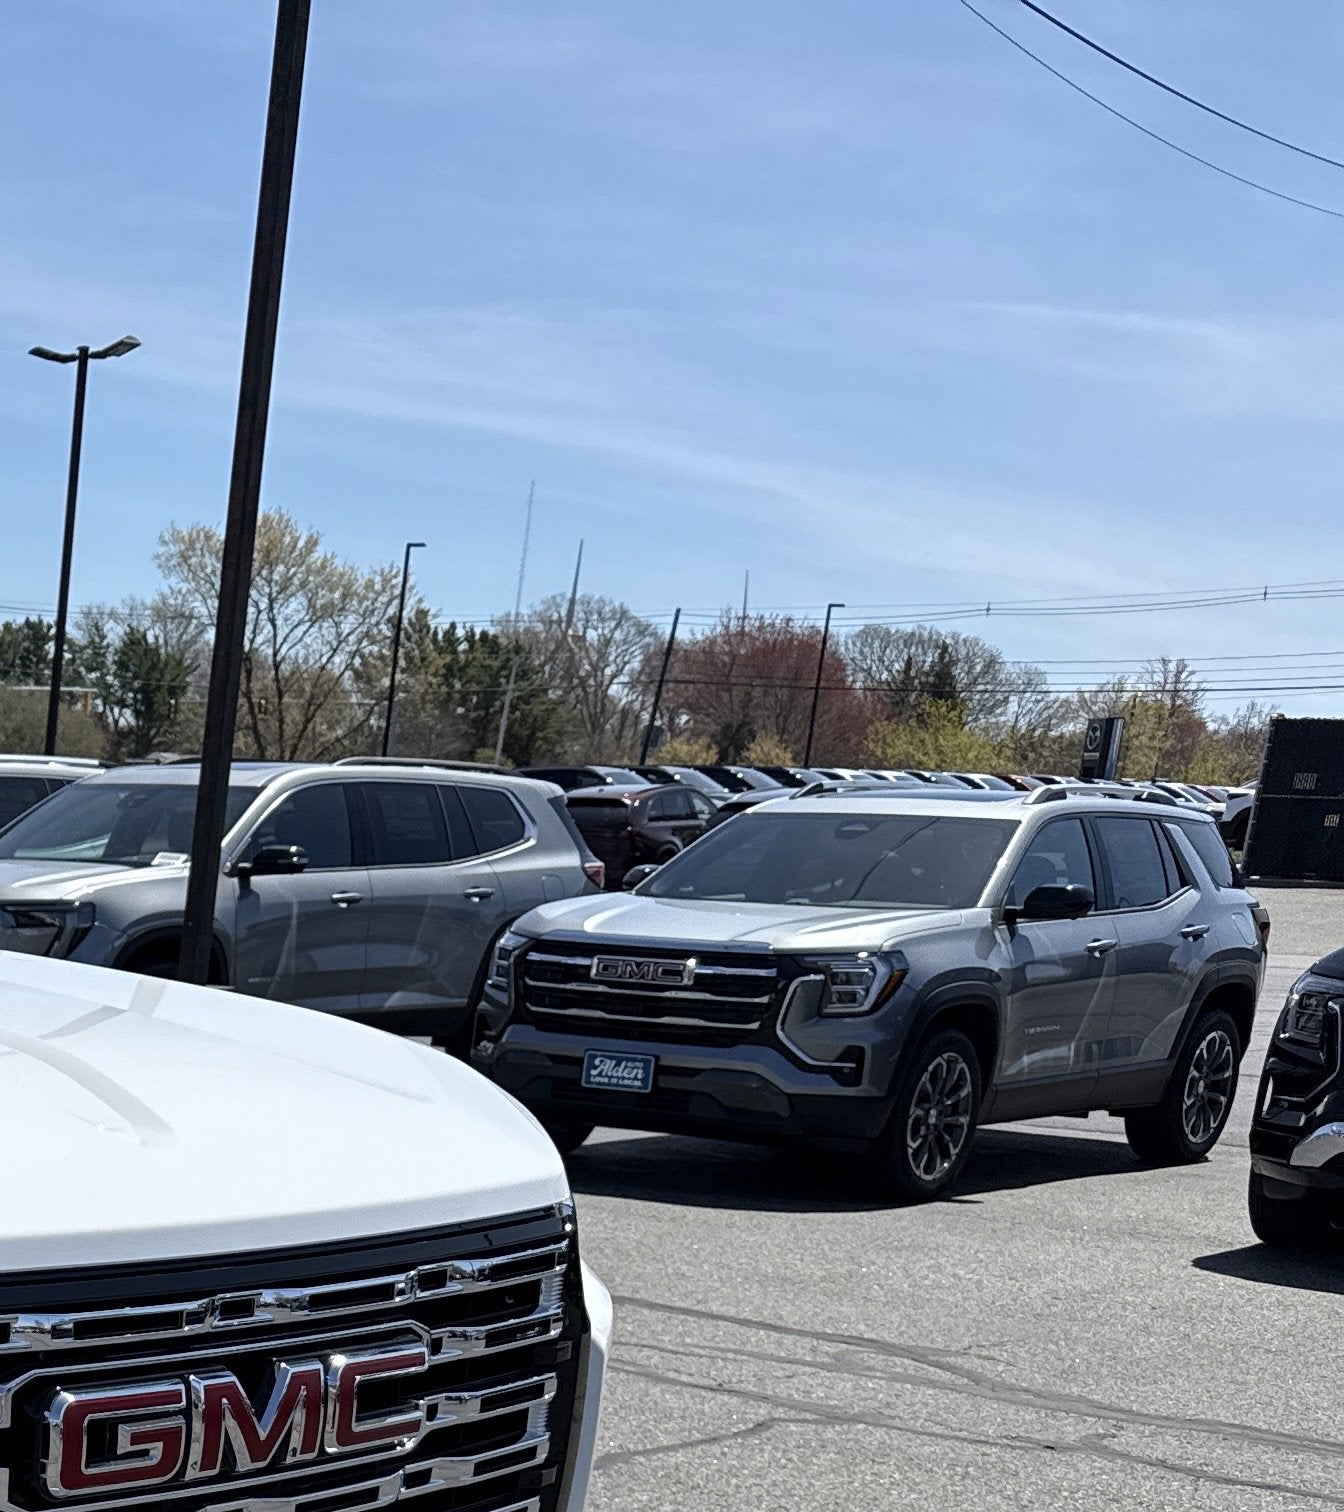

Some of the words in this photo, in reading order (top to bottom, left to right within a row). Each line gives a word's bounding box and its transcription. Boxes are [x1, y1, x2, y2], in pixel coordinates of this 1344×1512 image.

[598, 960, 685, 983] GMC
[590, 1056, 646, 1080] Alden
[46, 1342, 431, 1498] GMC
